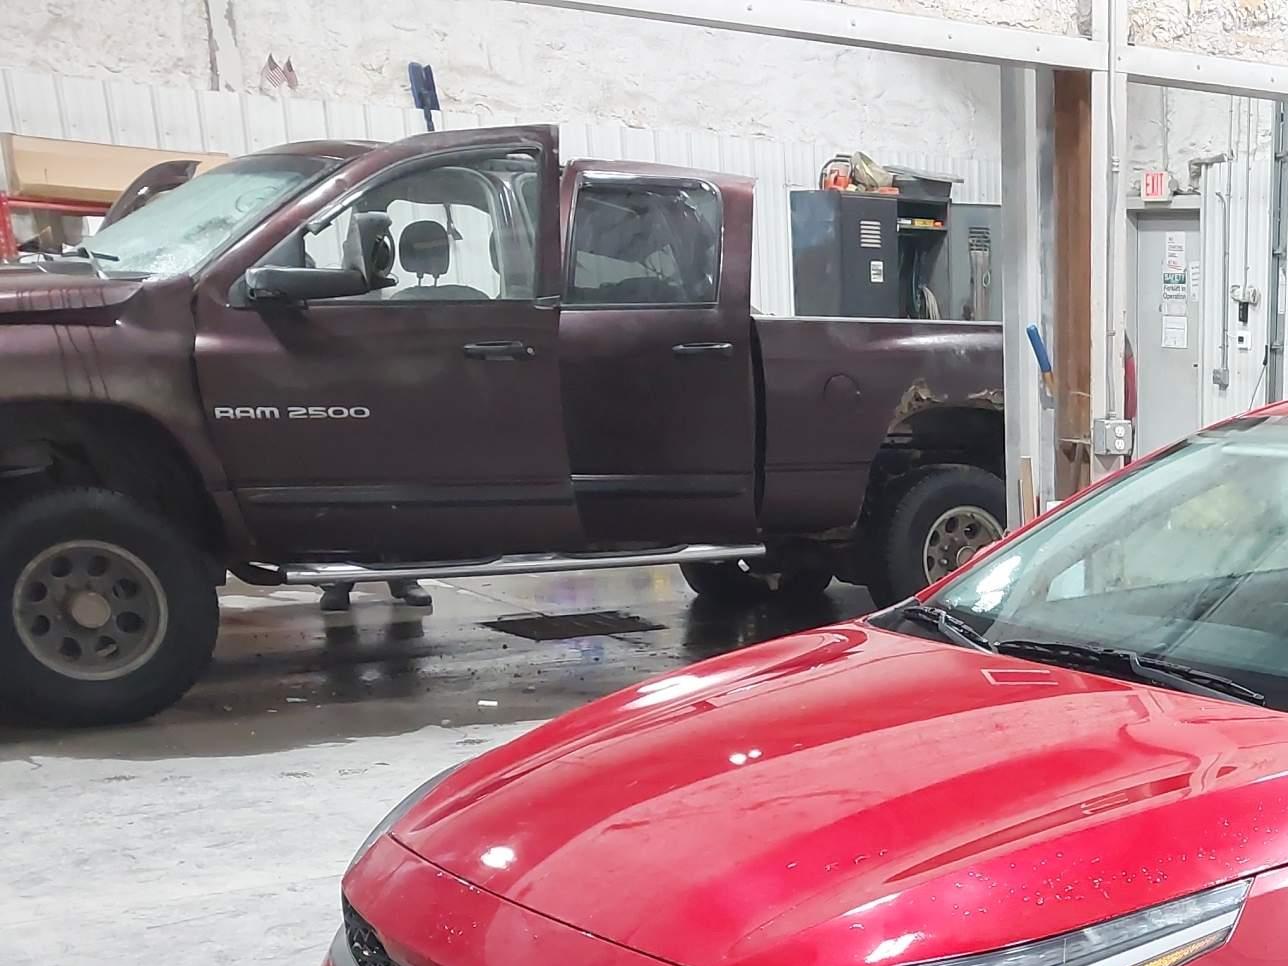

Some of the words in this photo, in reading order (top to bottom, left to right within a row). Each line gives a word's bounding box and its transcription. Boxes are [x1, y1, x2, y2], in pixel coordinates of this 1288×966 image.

[1145, 172, 1164, 196] EXIT
[214, 406, 280, 419] RAM
[287, 406, 371, 419] 2500
